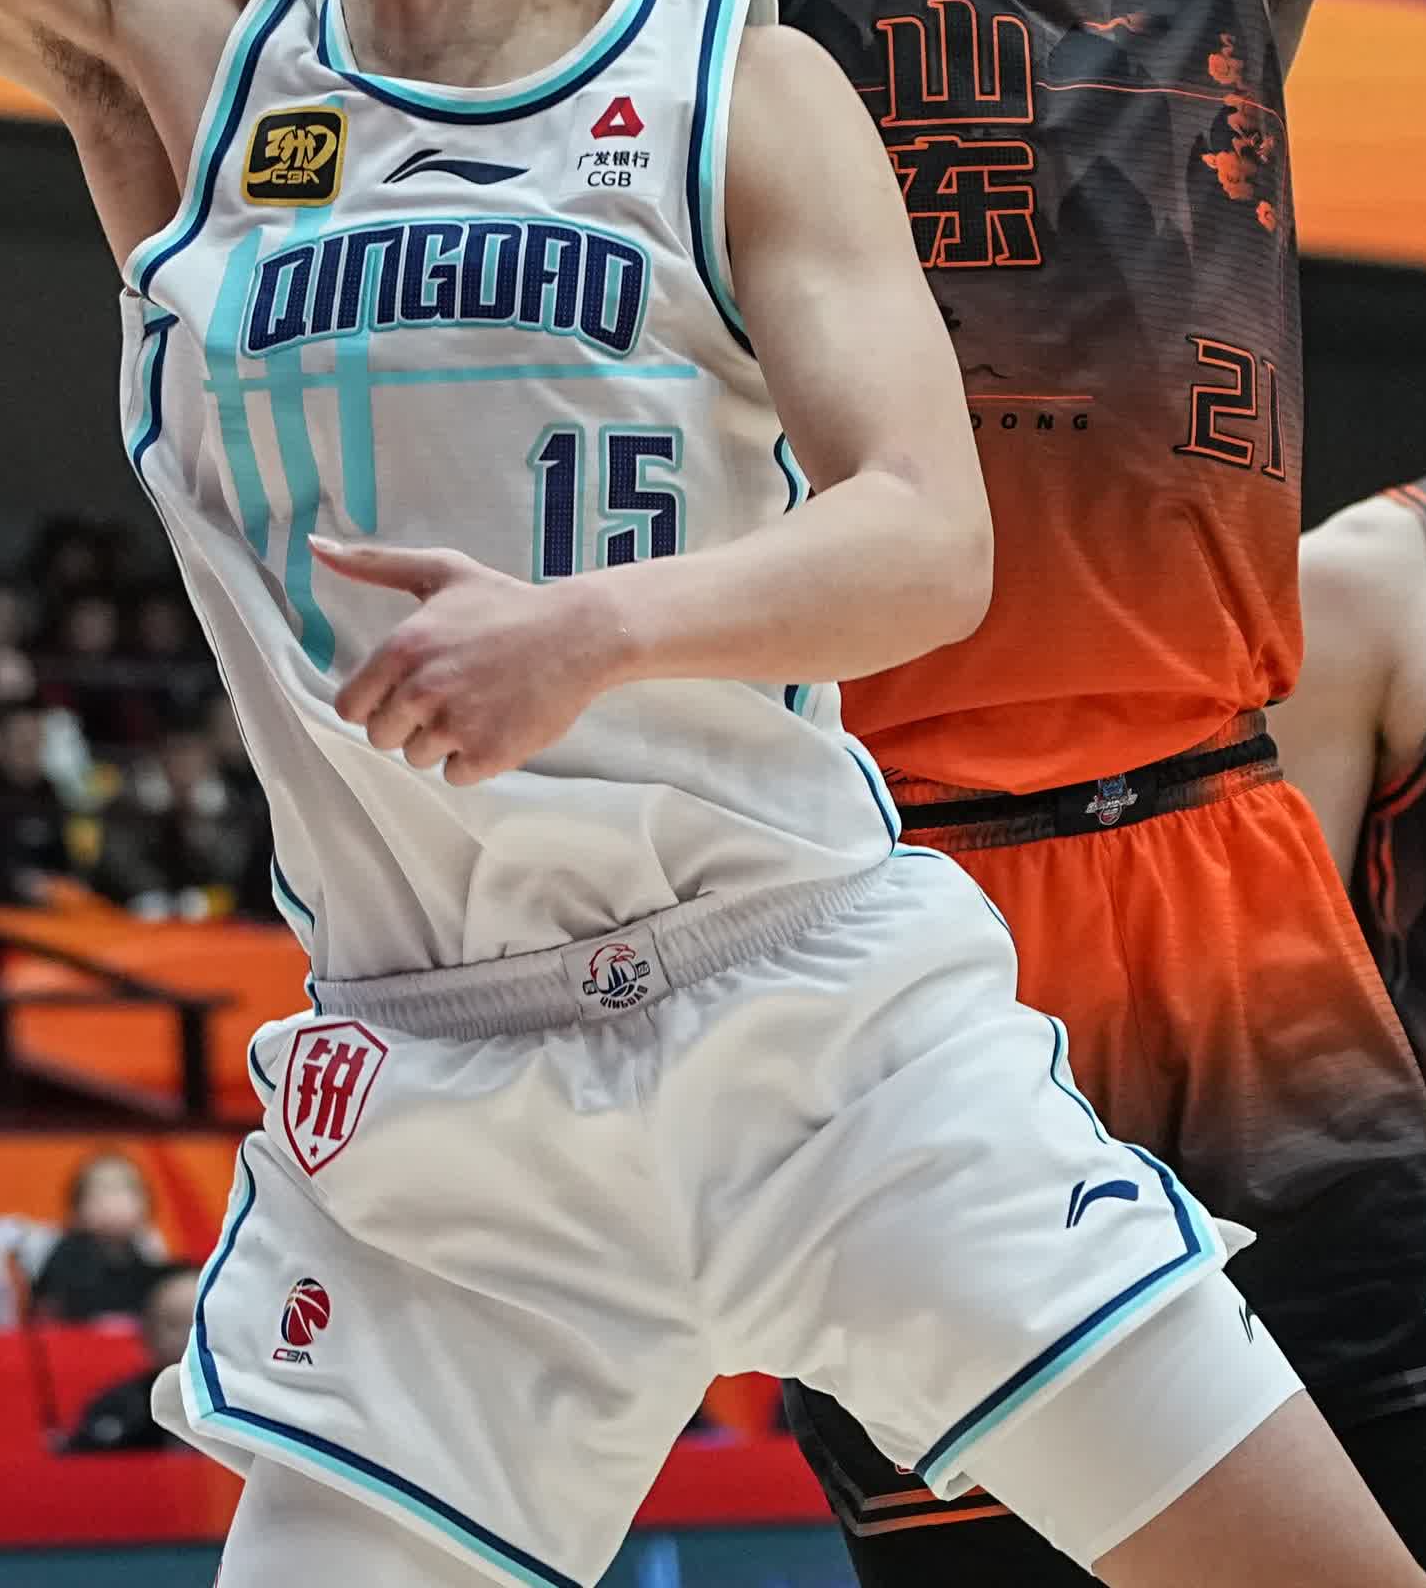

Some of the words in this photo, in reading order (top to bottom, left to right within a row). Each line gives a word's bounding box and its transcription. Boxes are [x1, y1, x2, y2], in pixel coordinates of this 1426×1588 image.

[576, 149, 651, 171] 广发银行
[270, 169, 321, 186] CBA
[587, 170, 632, 188] CGB
[240, 218, 651, 360] QINGDAO
[1173, 333, 1287, 482] 21
[527, 422, 686, 584] 15
[272, 1347, 313, 1365] CBA
